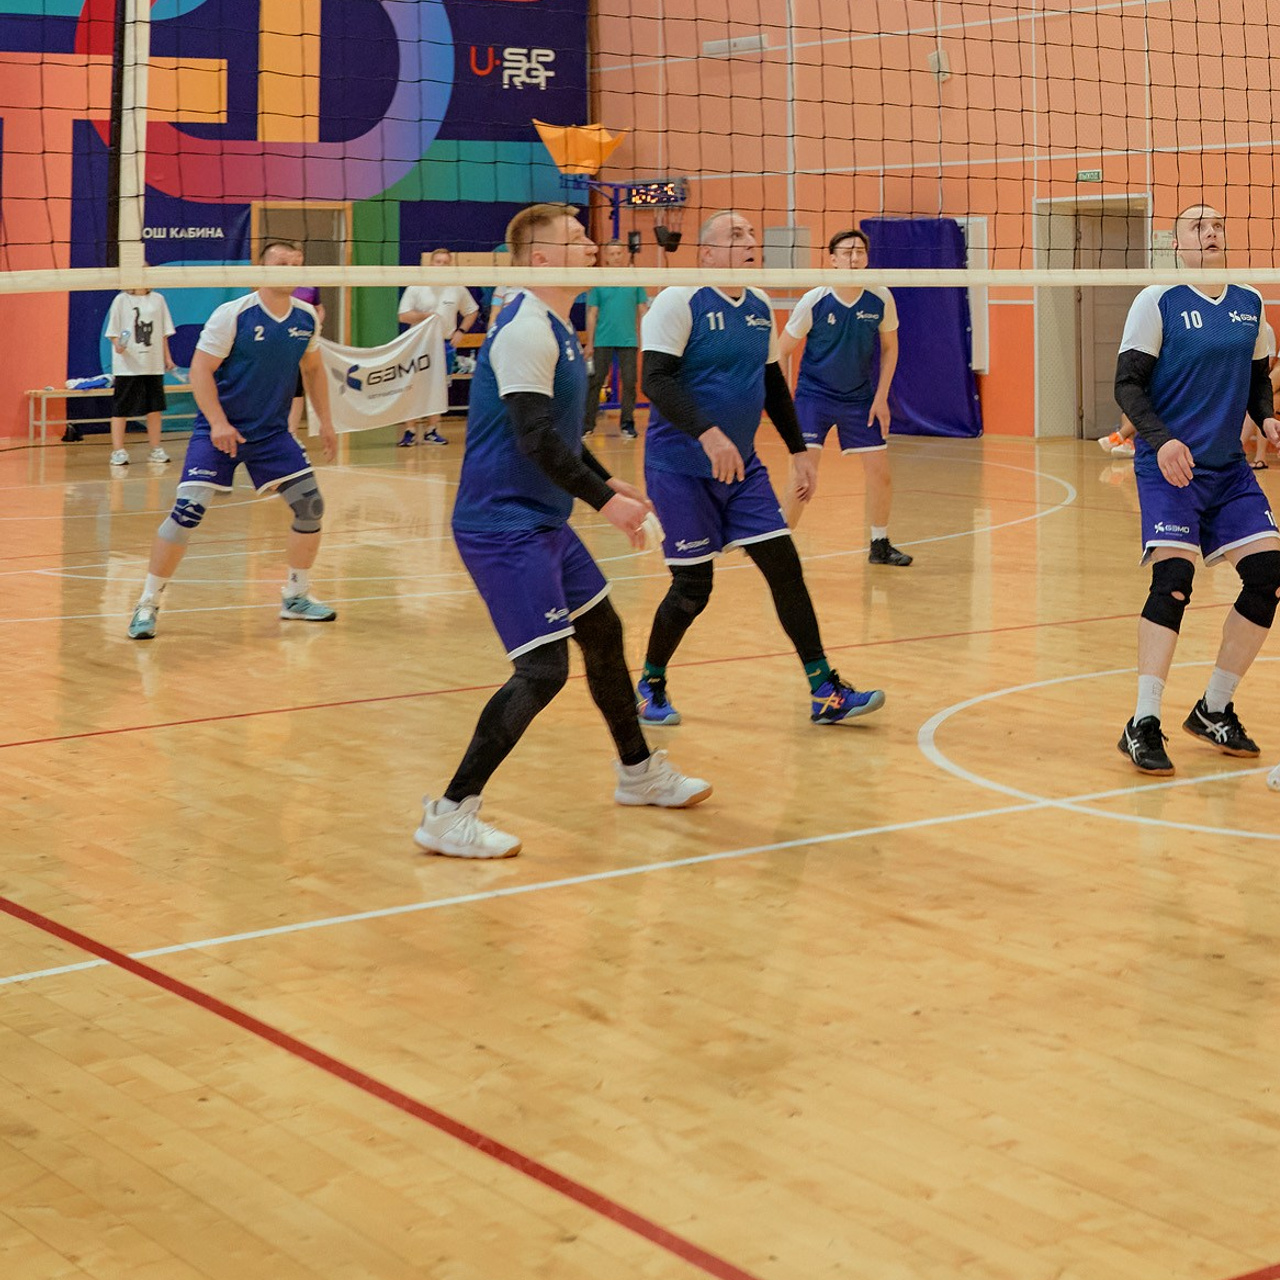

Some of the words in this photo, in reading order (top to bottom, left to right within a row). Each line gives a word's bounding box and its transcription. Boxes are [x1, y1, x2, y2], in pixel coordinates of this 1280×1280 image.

[142, 227, 166, 239] ОШ
[169, 227, 225, 239] КАБИНА
[706, 311, 726, 331] 11
[1180, 310, 1203, 330] 10
[253, 325, 265, 341] 2
